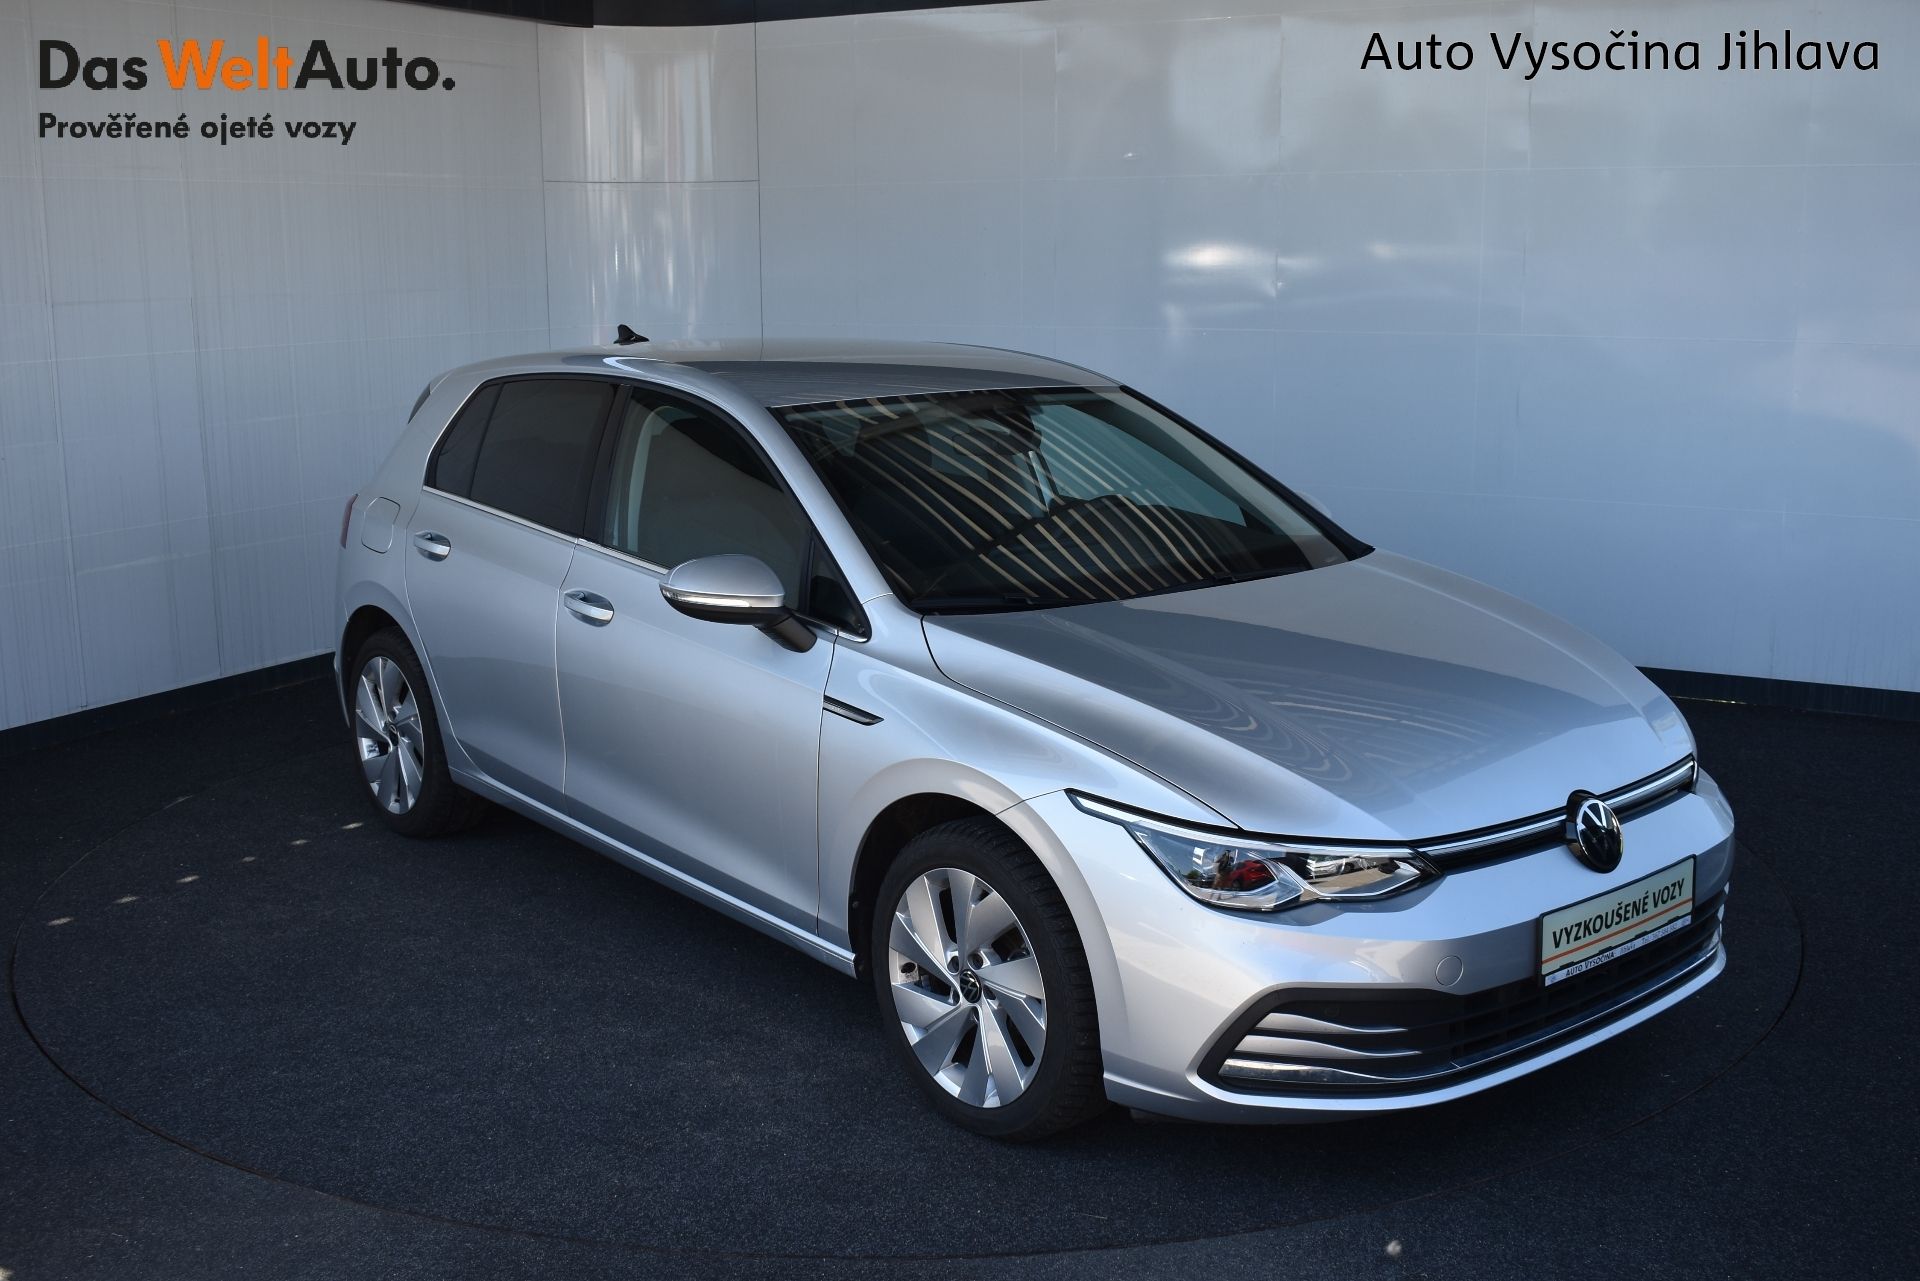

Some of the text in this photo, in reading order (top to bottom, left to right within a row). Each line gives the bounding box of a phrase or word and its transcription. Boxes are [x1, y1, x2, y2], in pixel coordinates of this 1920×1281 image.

[1552, 890, 1649, 949] VYZKOUŠENÉ
[1653, 878, 1685, 908] VOZY
[1565, 965, 1583, 977] AUTO
